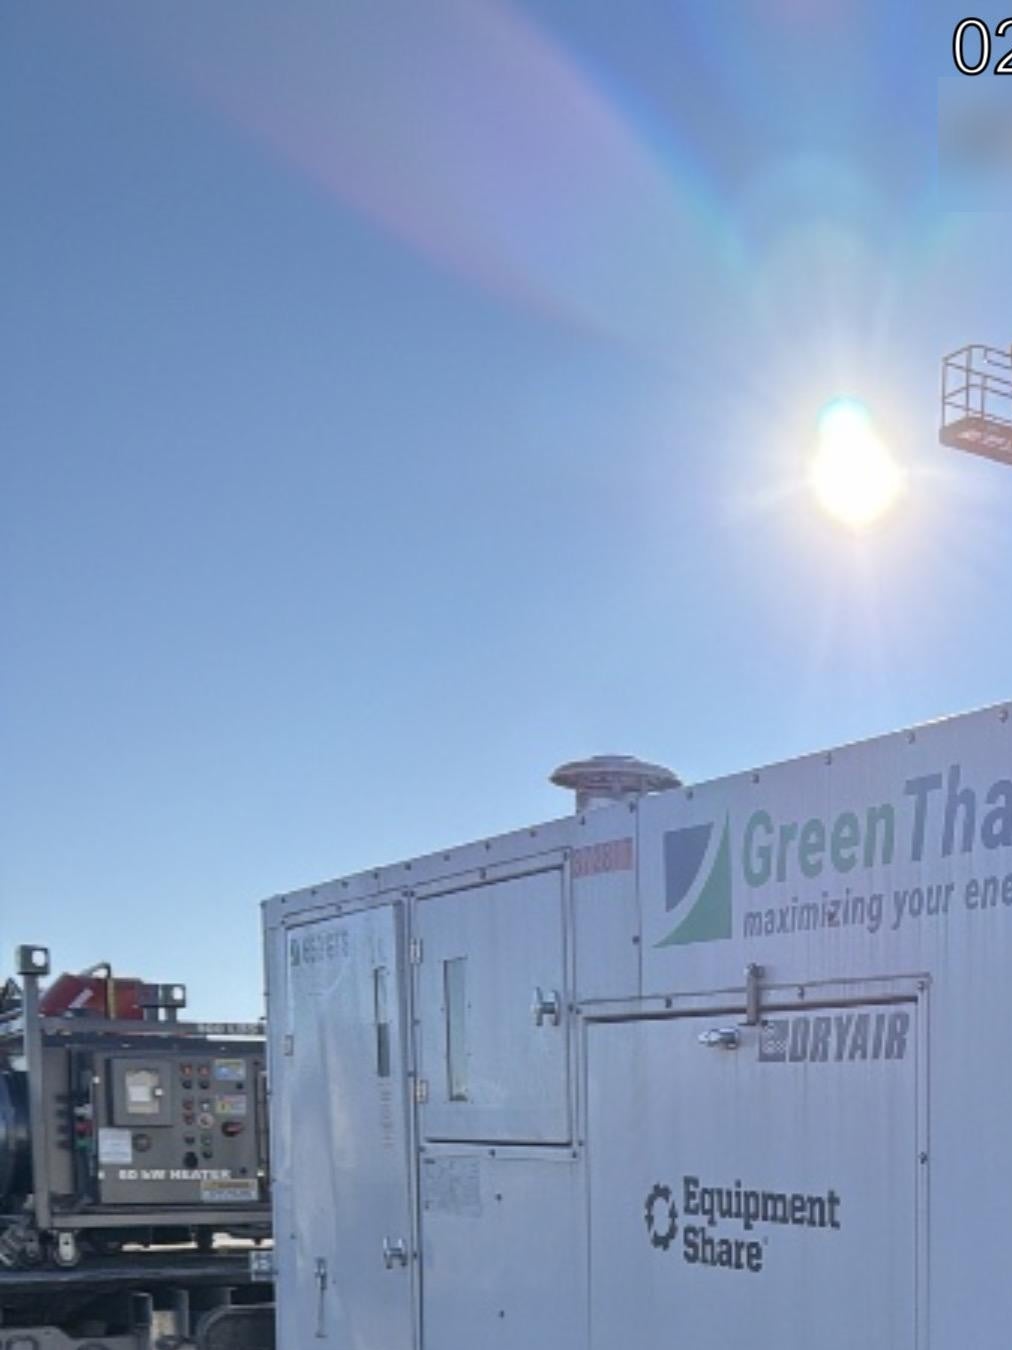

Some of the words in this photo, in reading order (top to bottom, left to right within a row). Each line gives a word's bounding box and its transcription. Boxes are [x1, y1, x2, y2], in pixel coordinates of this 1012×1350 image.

[743, 886, 883, 938] maximizing
[892, 881, 955, 931] your
[788, 1012, 910, 1063] DRYAIR
[683, 1175, 842, 1231] Equipment
[683, 1225, 763, 1273] Share
